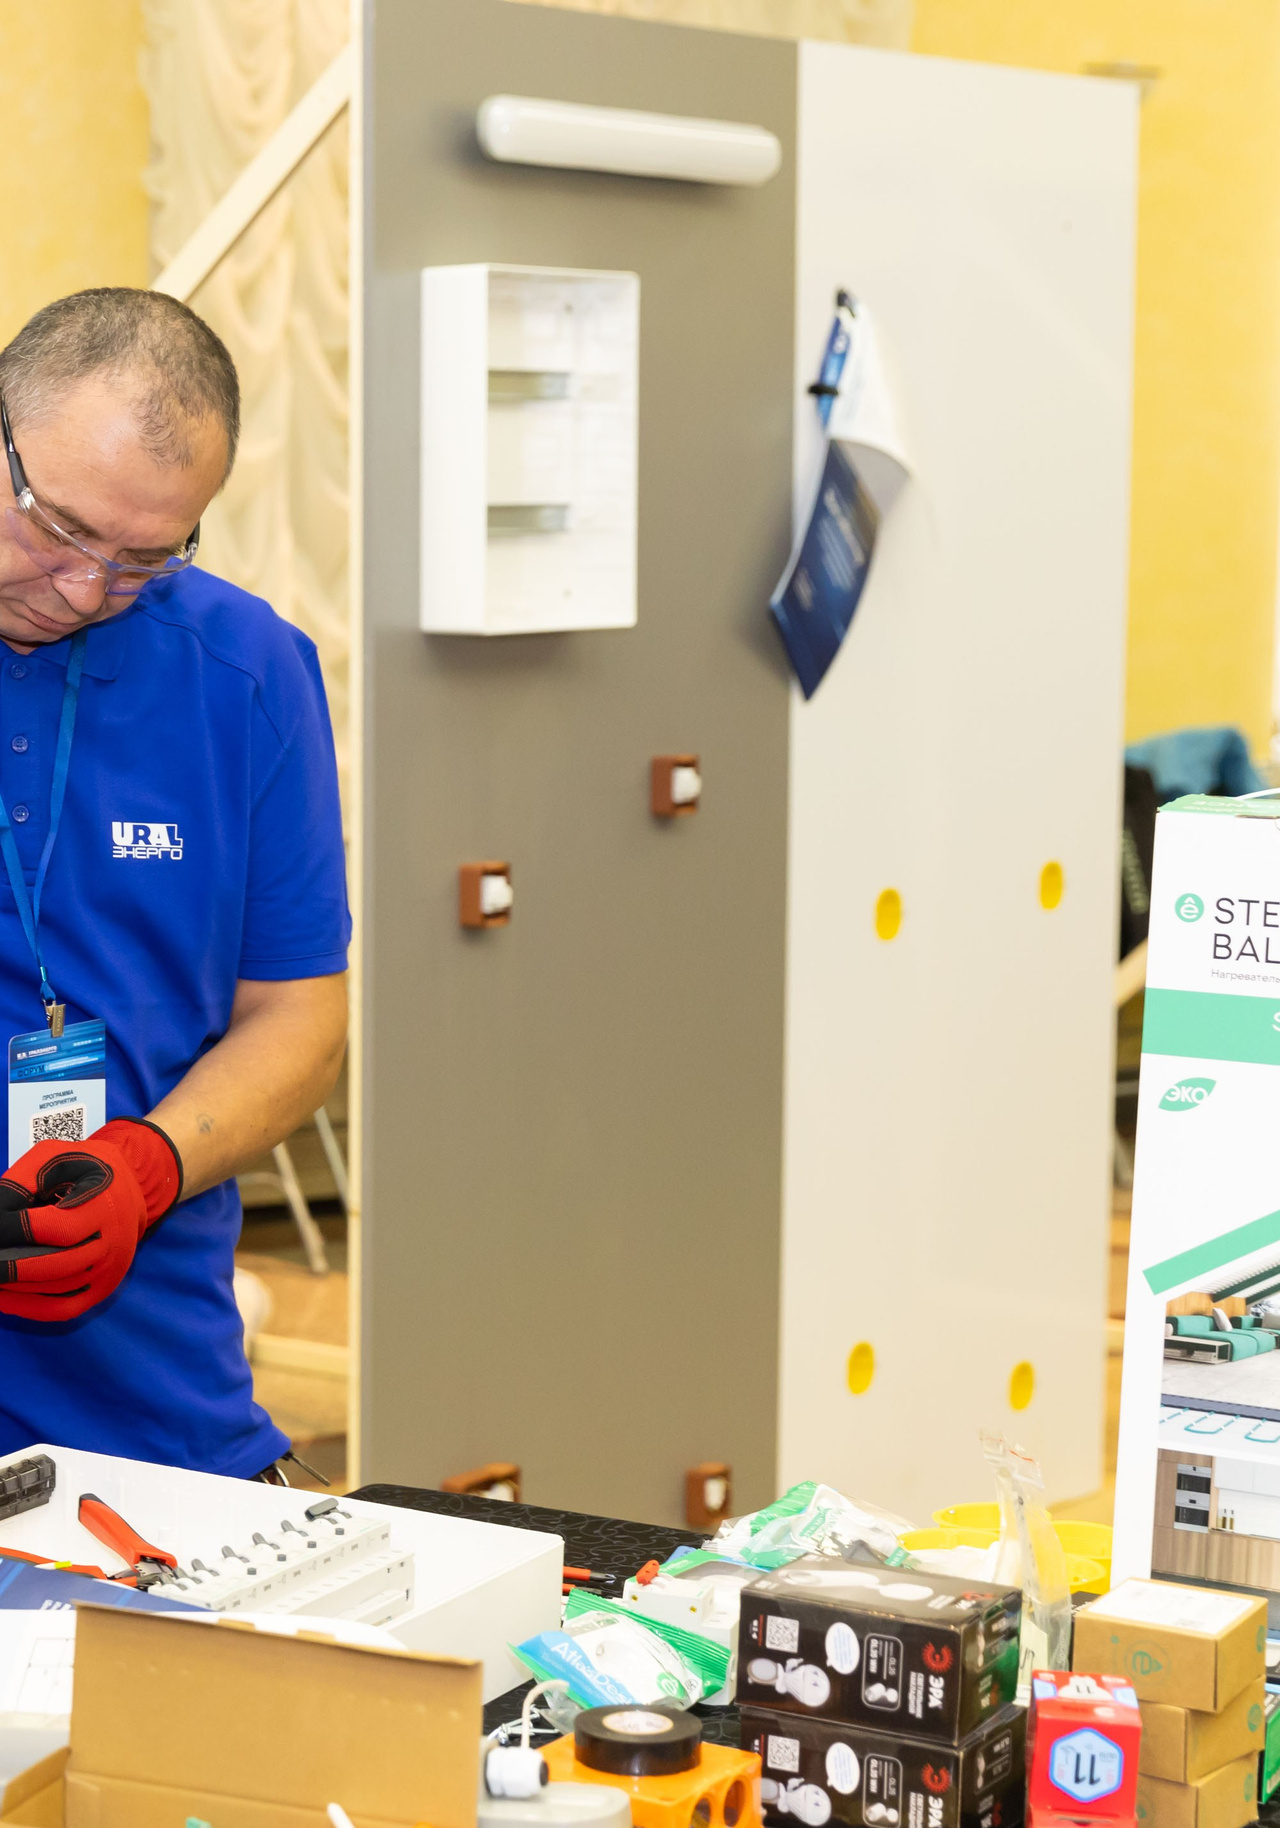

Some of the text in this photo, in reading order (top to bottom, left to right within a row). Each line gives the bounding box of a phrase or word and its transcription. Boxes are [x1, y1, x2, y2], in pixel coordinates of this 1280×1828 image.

[112, 821, 183, 848] URAL
[112, 845, 183, 860] ЭНЕРГО
[1212, 933, 1280, 964] BAL
[39, 1096, 77, 1109] МЕРОПРИЯТИЯ
[42, 1089, 74, 1101] ПРОГРАММА
[1165, 1085, 1209, 1105] ЭКО
[928, 1674, 945, 1708] ЭРА
